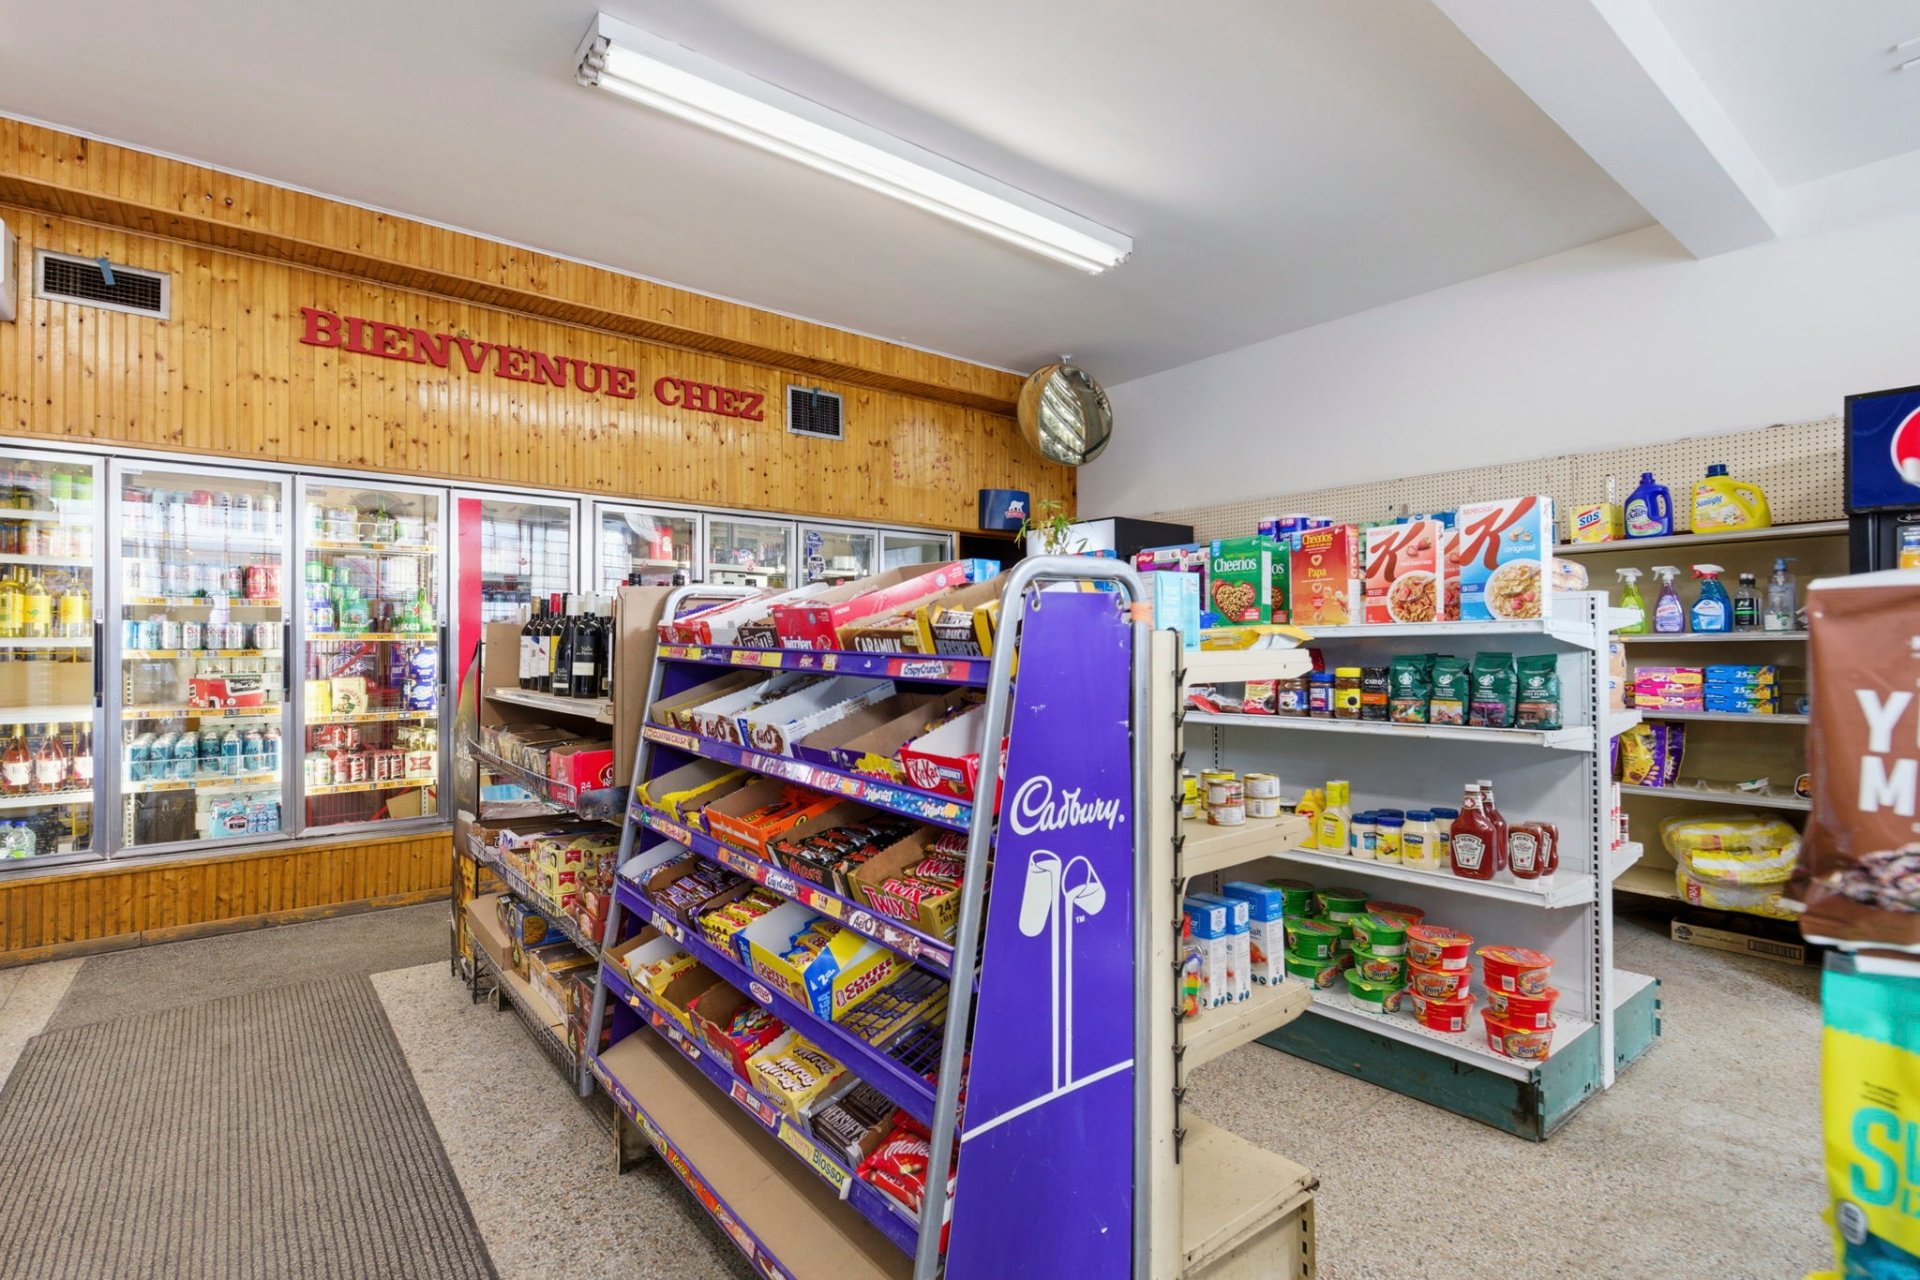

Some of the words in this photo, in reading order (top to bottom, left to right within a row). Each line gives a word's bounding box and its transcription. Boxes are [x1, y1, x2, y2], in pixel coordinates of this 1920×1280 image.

[300, 307, 636, 399] BIENVENUE
[654, 376, 764, 421] CHEZ
[1302, 533, 1333, 547] Cheerios
[1213, 557, 1258, 574] Cheerios
[1307, 567, 1328, 579] Papa
[854, 636, 902, 653] CARAMILK
[845, 957, 893, 993] COFFEE
[846, 969, 892, 1001] CRISP
